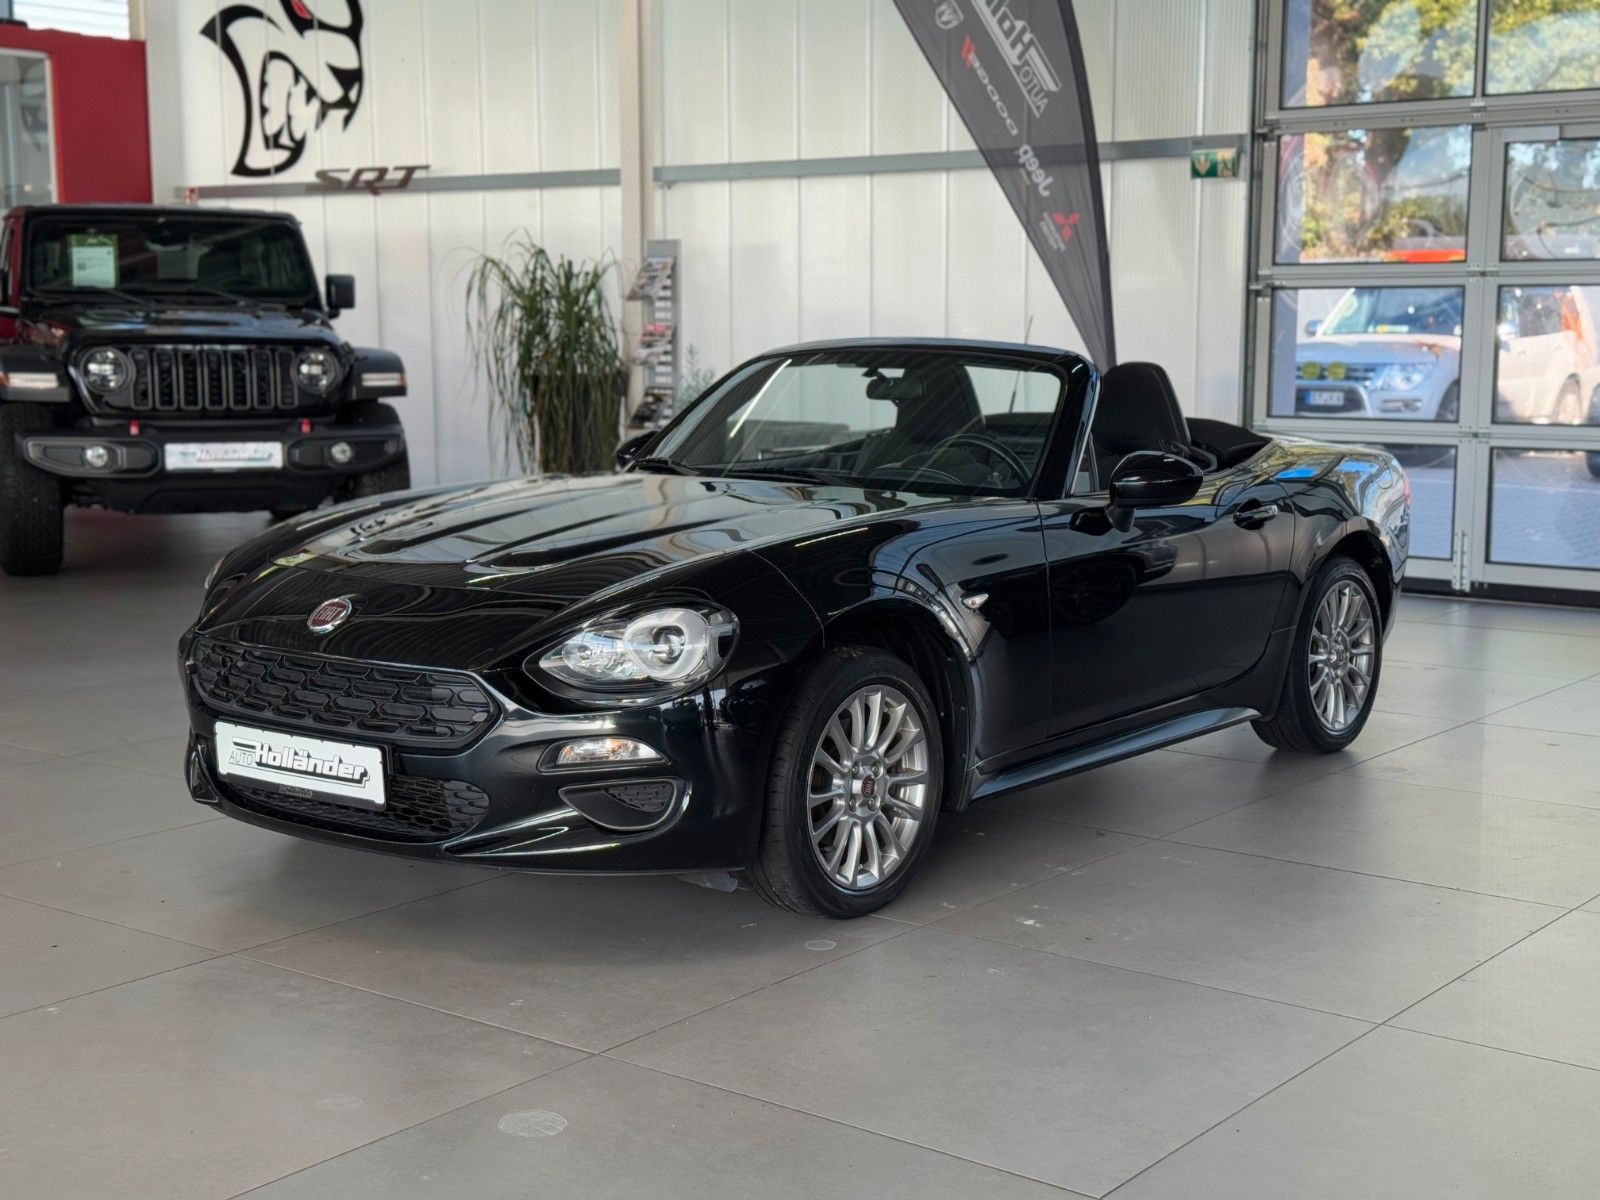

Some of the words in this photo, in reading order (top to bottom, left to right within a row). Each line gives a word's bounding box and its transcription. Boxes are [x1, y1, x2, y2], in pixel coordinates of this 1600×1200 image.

[305, 165, 430, 196] SRT
[313, 605, 343, 622] FIAT
[228, 750, 254, 766] AUTO
[256, 742, 369, 783] Holländer
